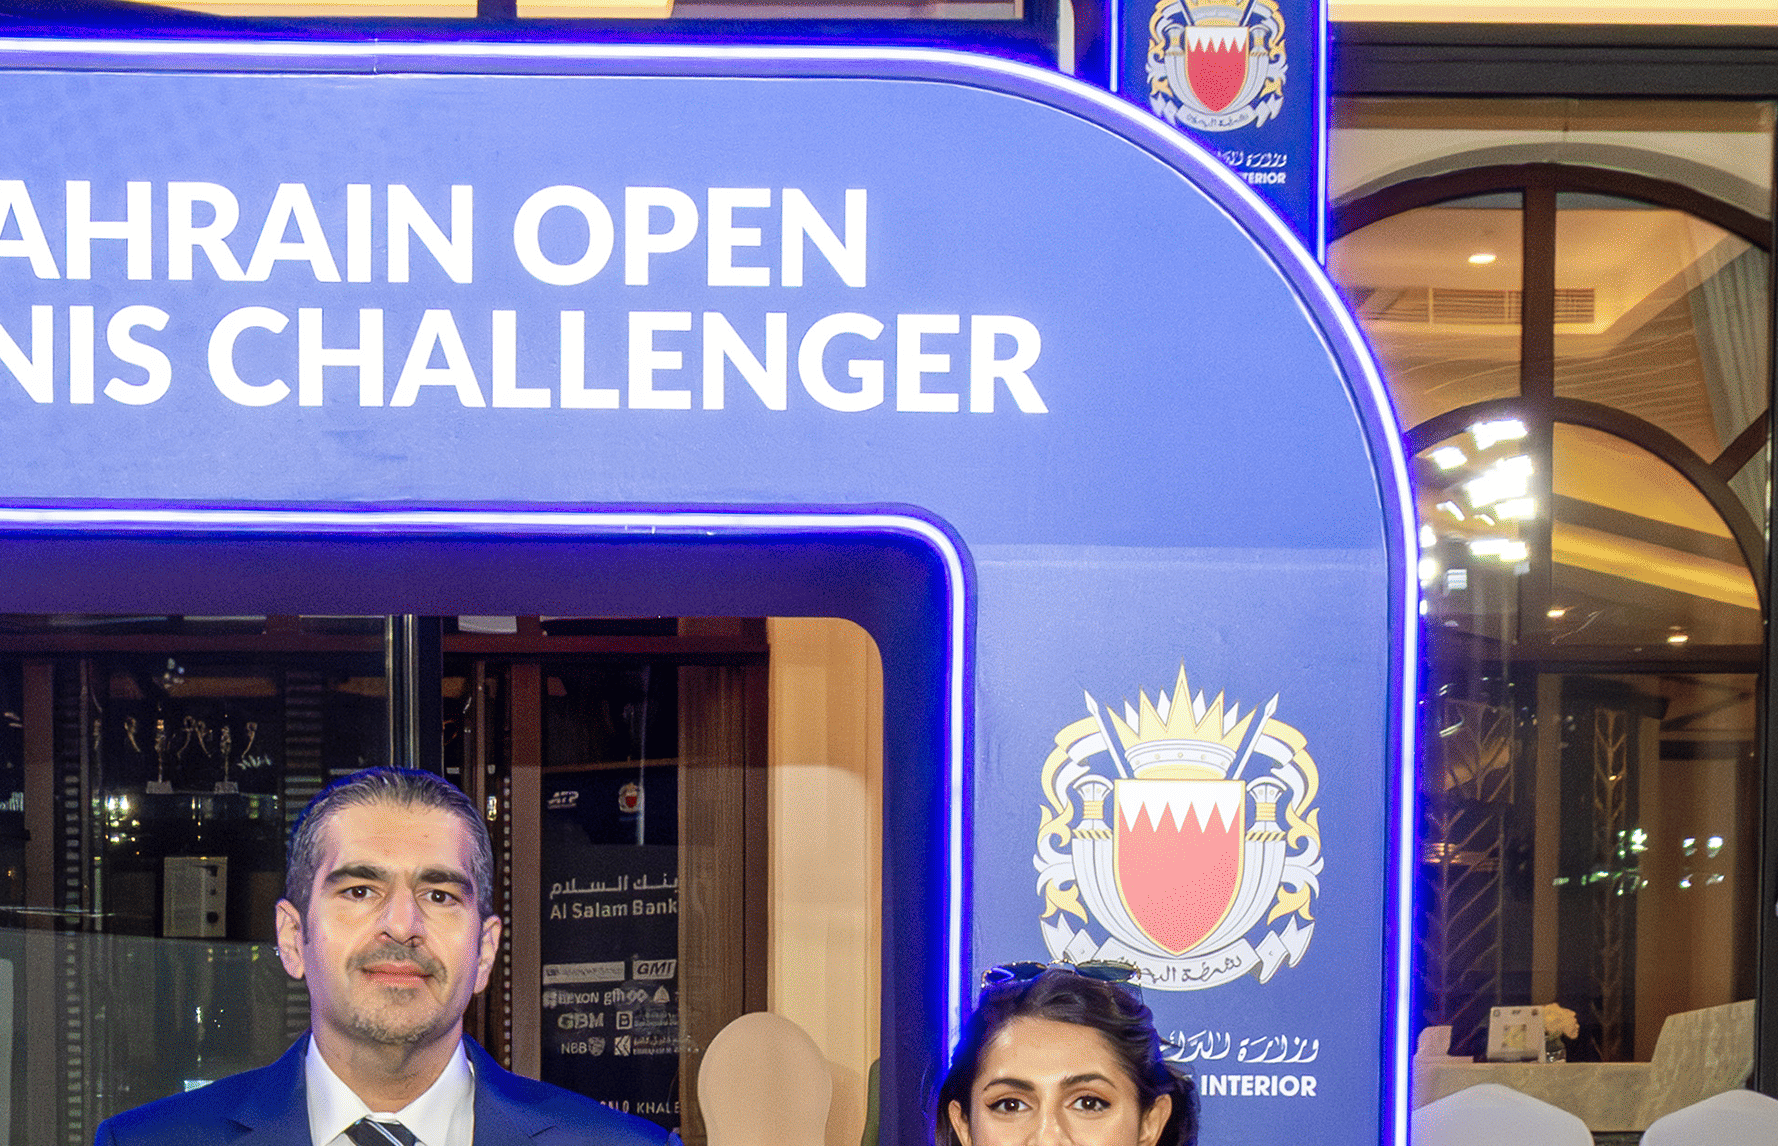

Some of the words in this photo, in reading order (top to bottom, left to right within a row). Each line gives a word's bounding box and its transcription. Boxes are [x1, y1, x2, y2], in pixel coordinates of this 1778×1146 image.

[512, 185, 868, 288] OPEN
[207, 306, 1049, 413] CHALLENGER
[550, 903, 567, 919] Al
[571, 901, 628, 919] Salam
[632, 898, 678, 916] Bank
[1201, 1074, 1317, 1097] INTERIOR
